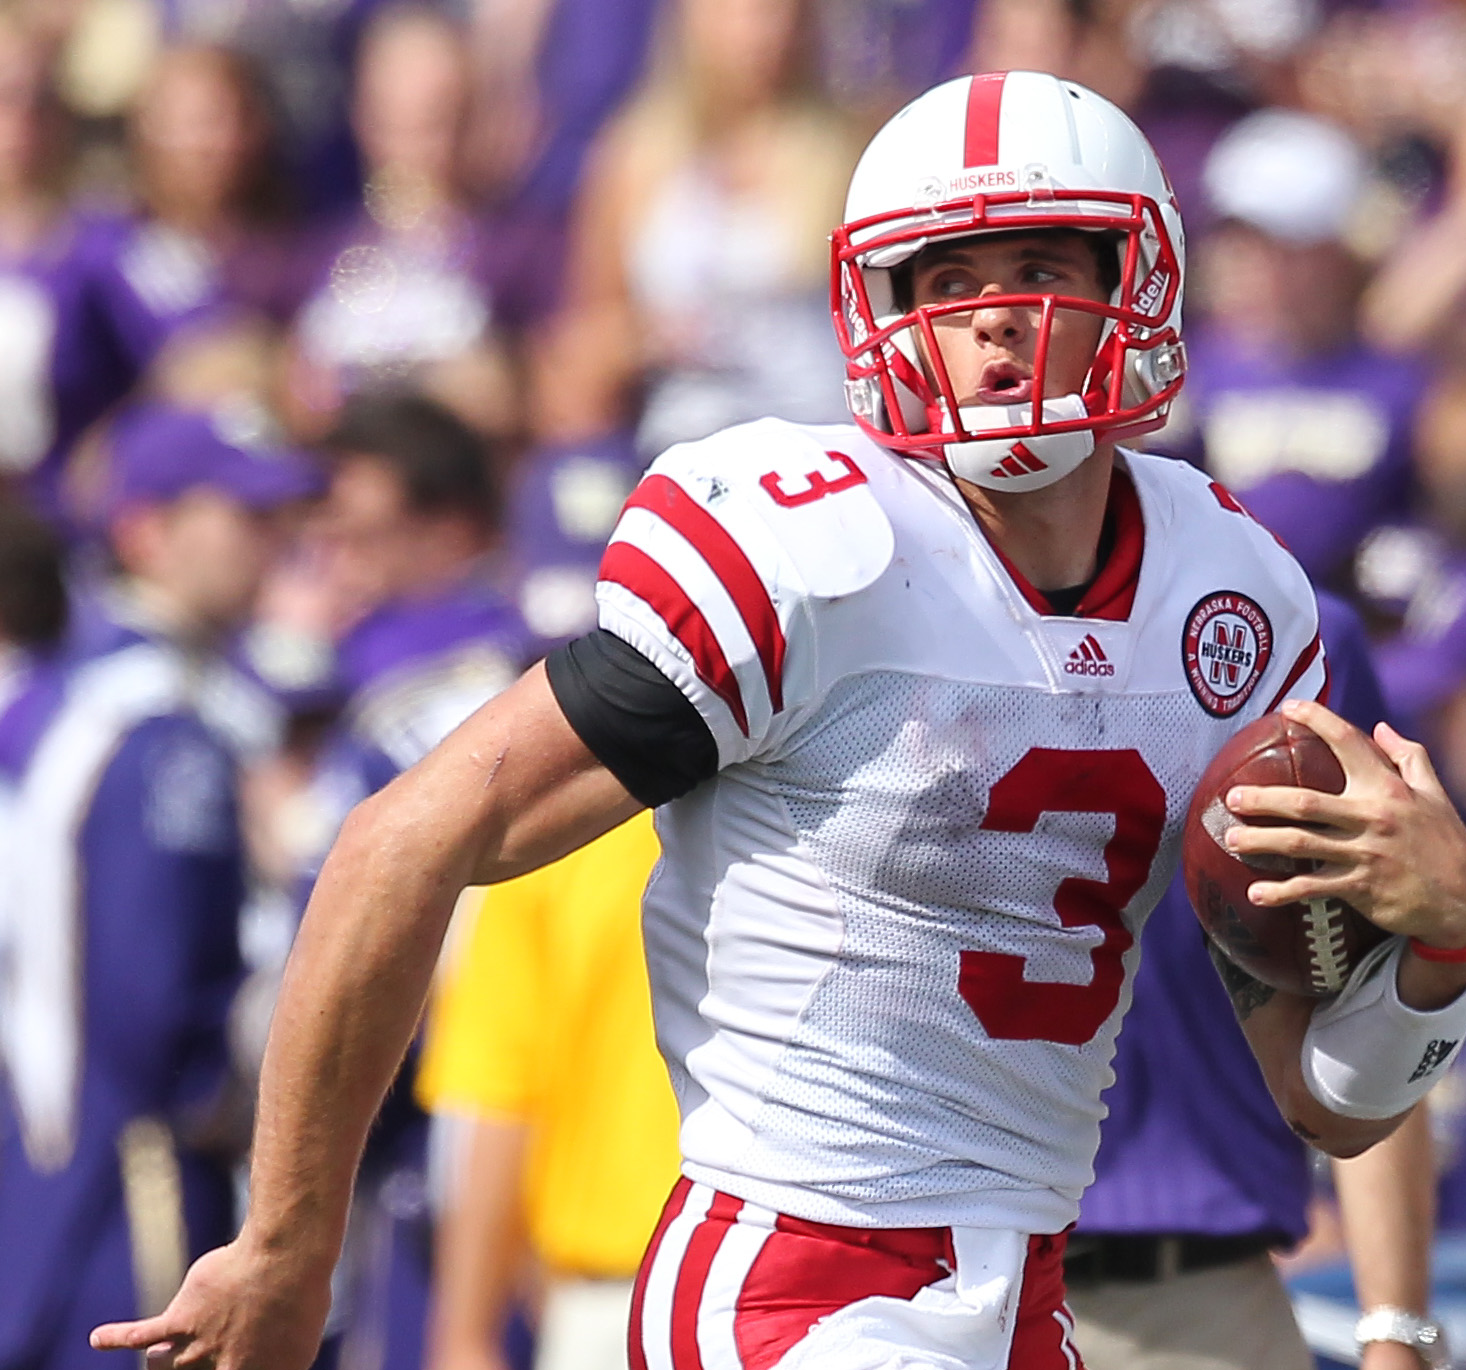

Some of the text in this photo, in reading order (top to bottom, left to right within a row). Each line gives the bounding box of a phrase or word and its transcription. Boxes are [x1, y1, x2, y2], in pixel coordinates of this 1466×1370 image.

[949, 171, 1015, 193] HUSKERS
[759, 449, 868, 509] 3
[1188, 597, 1269, 655] NEBRASKA FOOTBALL
[1064, 659, 1115, 677] adidas
[1200, 641, 1253, 668] HUSKERS
[956, 746, 1167, 1048] 3
